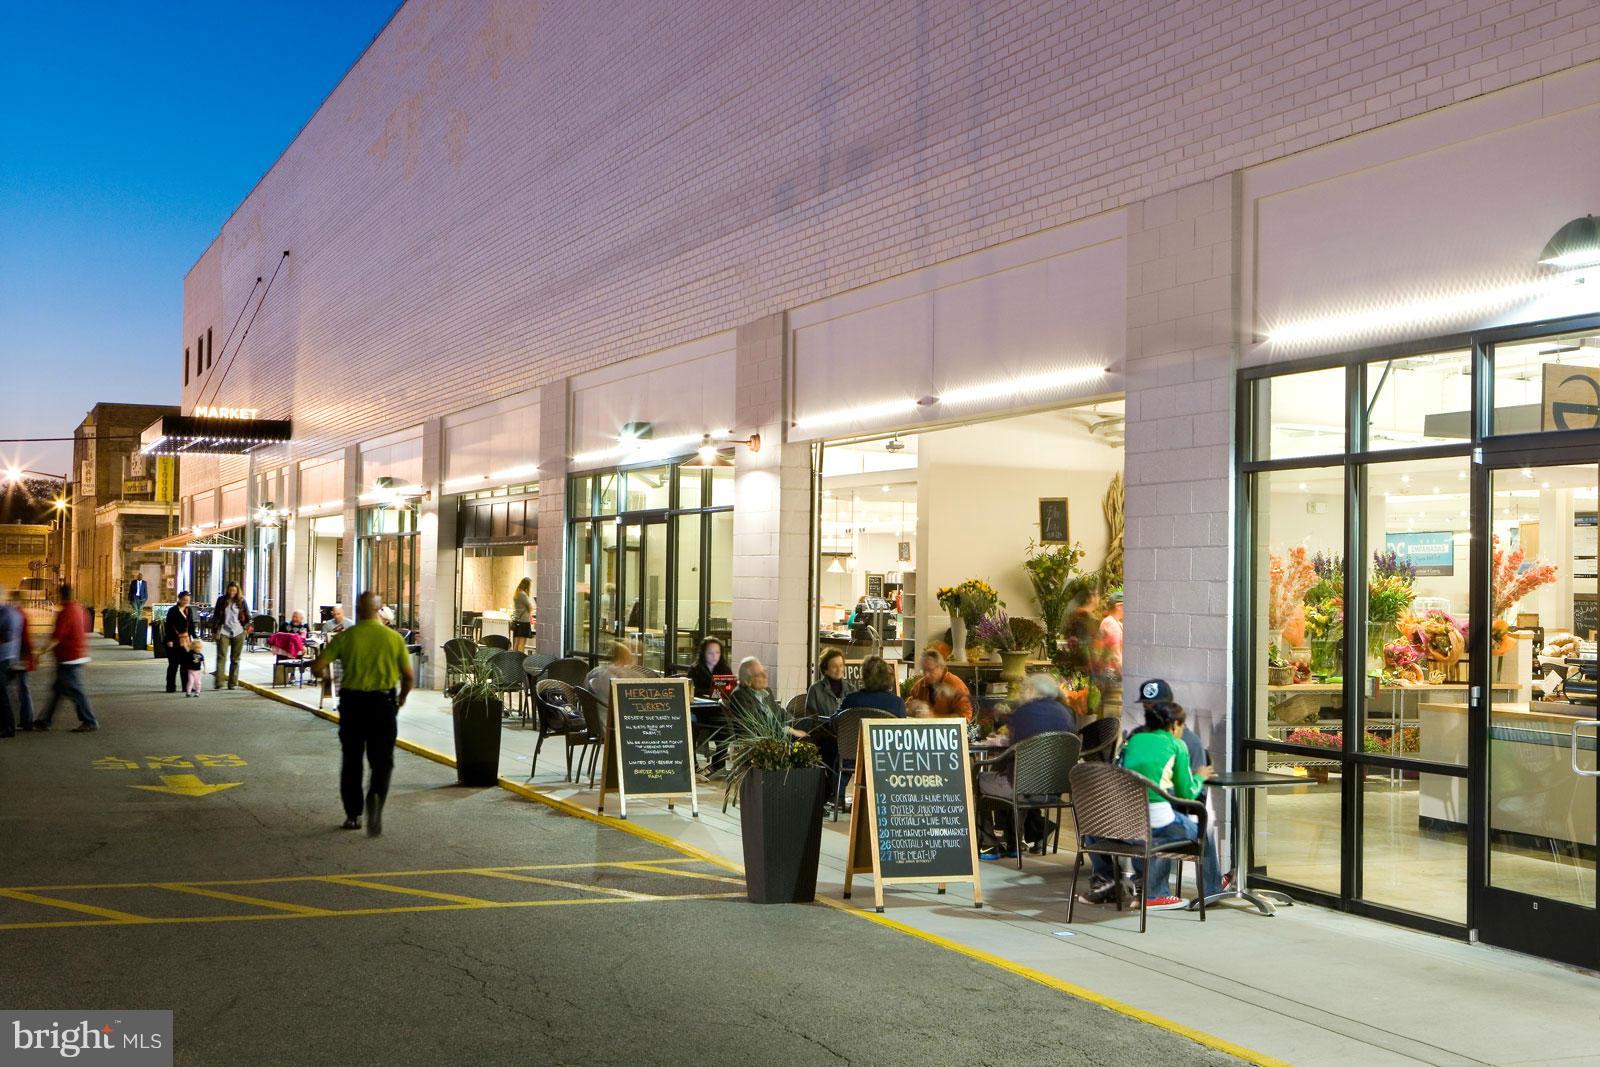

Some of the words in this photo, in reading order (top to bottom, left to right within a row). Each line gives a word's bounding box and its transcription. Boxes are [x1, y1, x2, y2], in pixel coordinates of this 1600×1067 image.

[195, 406, 258, 420] MARKET
[624, 688, 676, 698] HERITAGE
[872, 728, 959, 751] UPCOMING
[874, 752, 960, 772] EVENTS
[889, 774, 944, 788] OCTOBER
[876, 793, 887, 804] 12
[890, 794, 924, 802] COCKTAILS
[928, 794, 942, 802] LIVE
[942, 794, 962, 802] MUSIC
[877, 806, 887, 815] 13
[890, 805, 915, 814] OYSTER
[947, 805, 965, 814] COMP
[878, 817, 888, 827] 19
[890, 816, 920, 826] COCKTAILS
[926, 816, 940, 825] LIVE
[942, 816, 961, 825] MUSIC
[879, 829, 890, 838] 20
[890, 829, 903, 837] THE
[880, 840, 891, 850] 26
[892, 839, 924, 848] COCKTAILS
[929, 839, 942, 848] LIVE
[943, 839, 961, 848] MUSIC
[880, 850, 892, 861] 27
[893, 850, 907, 860] THE
[907, 850, 937, 860] MEAT-UP
